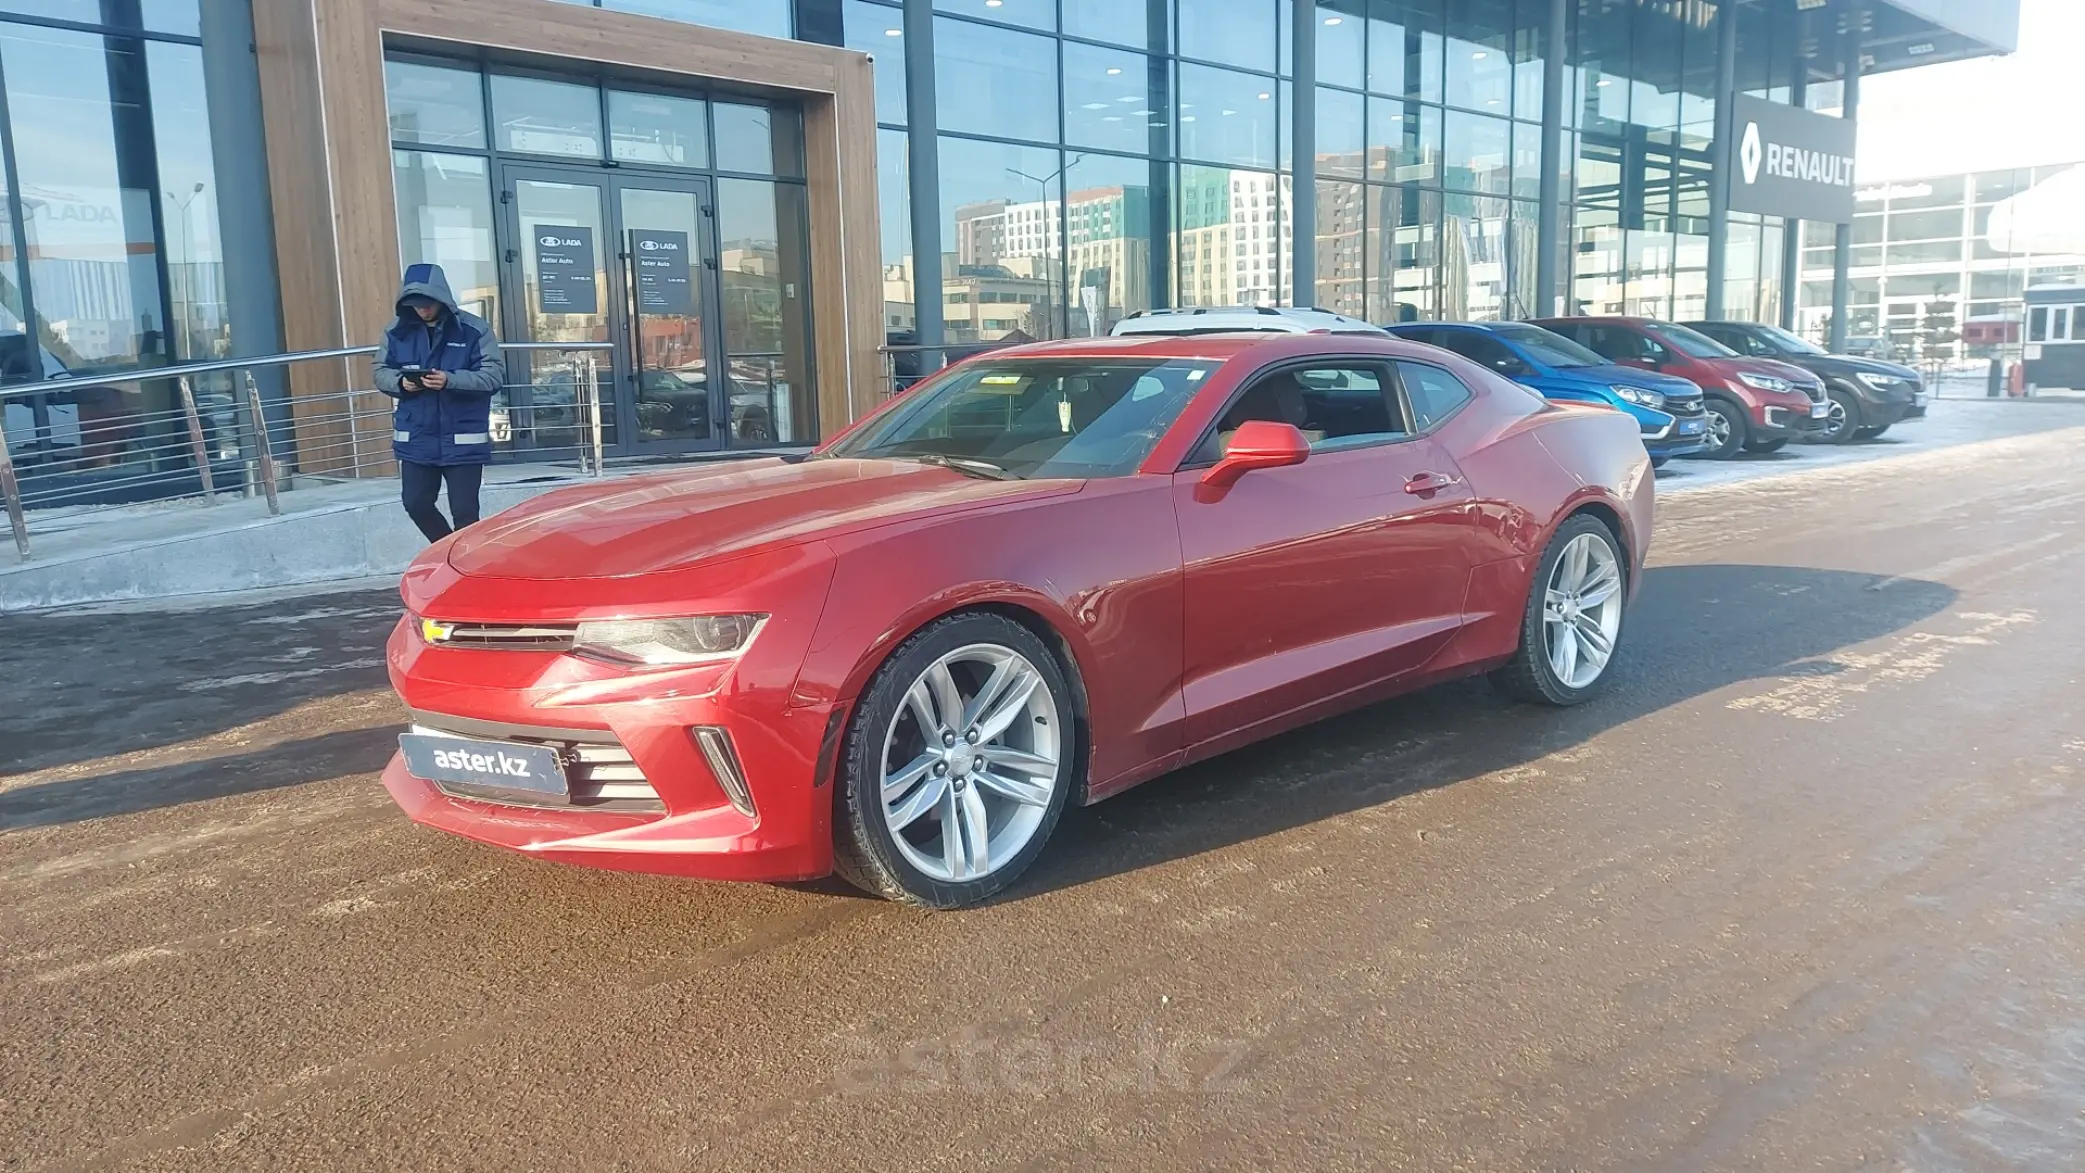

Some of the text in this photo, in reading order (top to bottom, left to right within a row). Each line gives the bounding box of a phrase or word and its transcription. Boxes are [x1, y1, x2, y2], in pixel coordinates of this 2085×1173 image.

[1766, 142, 1854, 187] RENAULT
[46, 203, 118, 224] LADA
[561, 238, 582, 246] LADA
[659, 242, 678, 250] LADA
[433, 748, 531, 777] aster.kz
